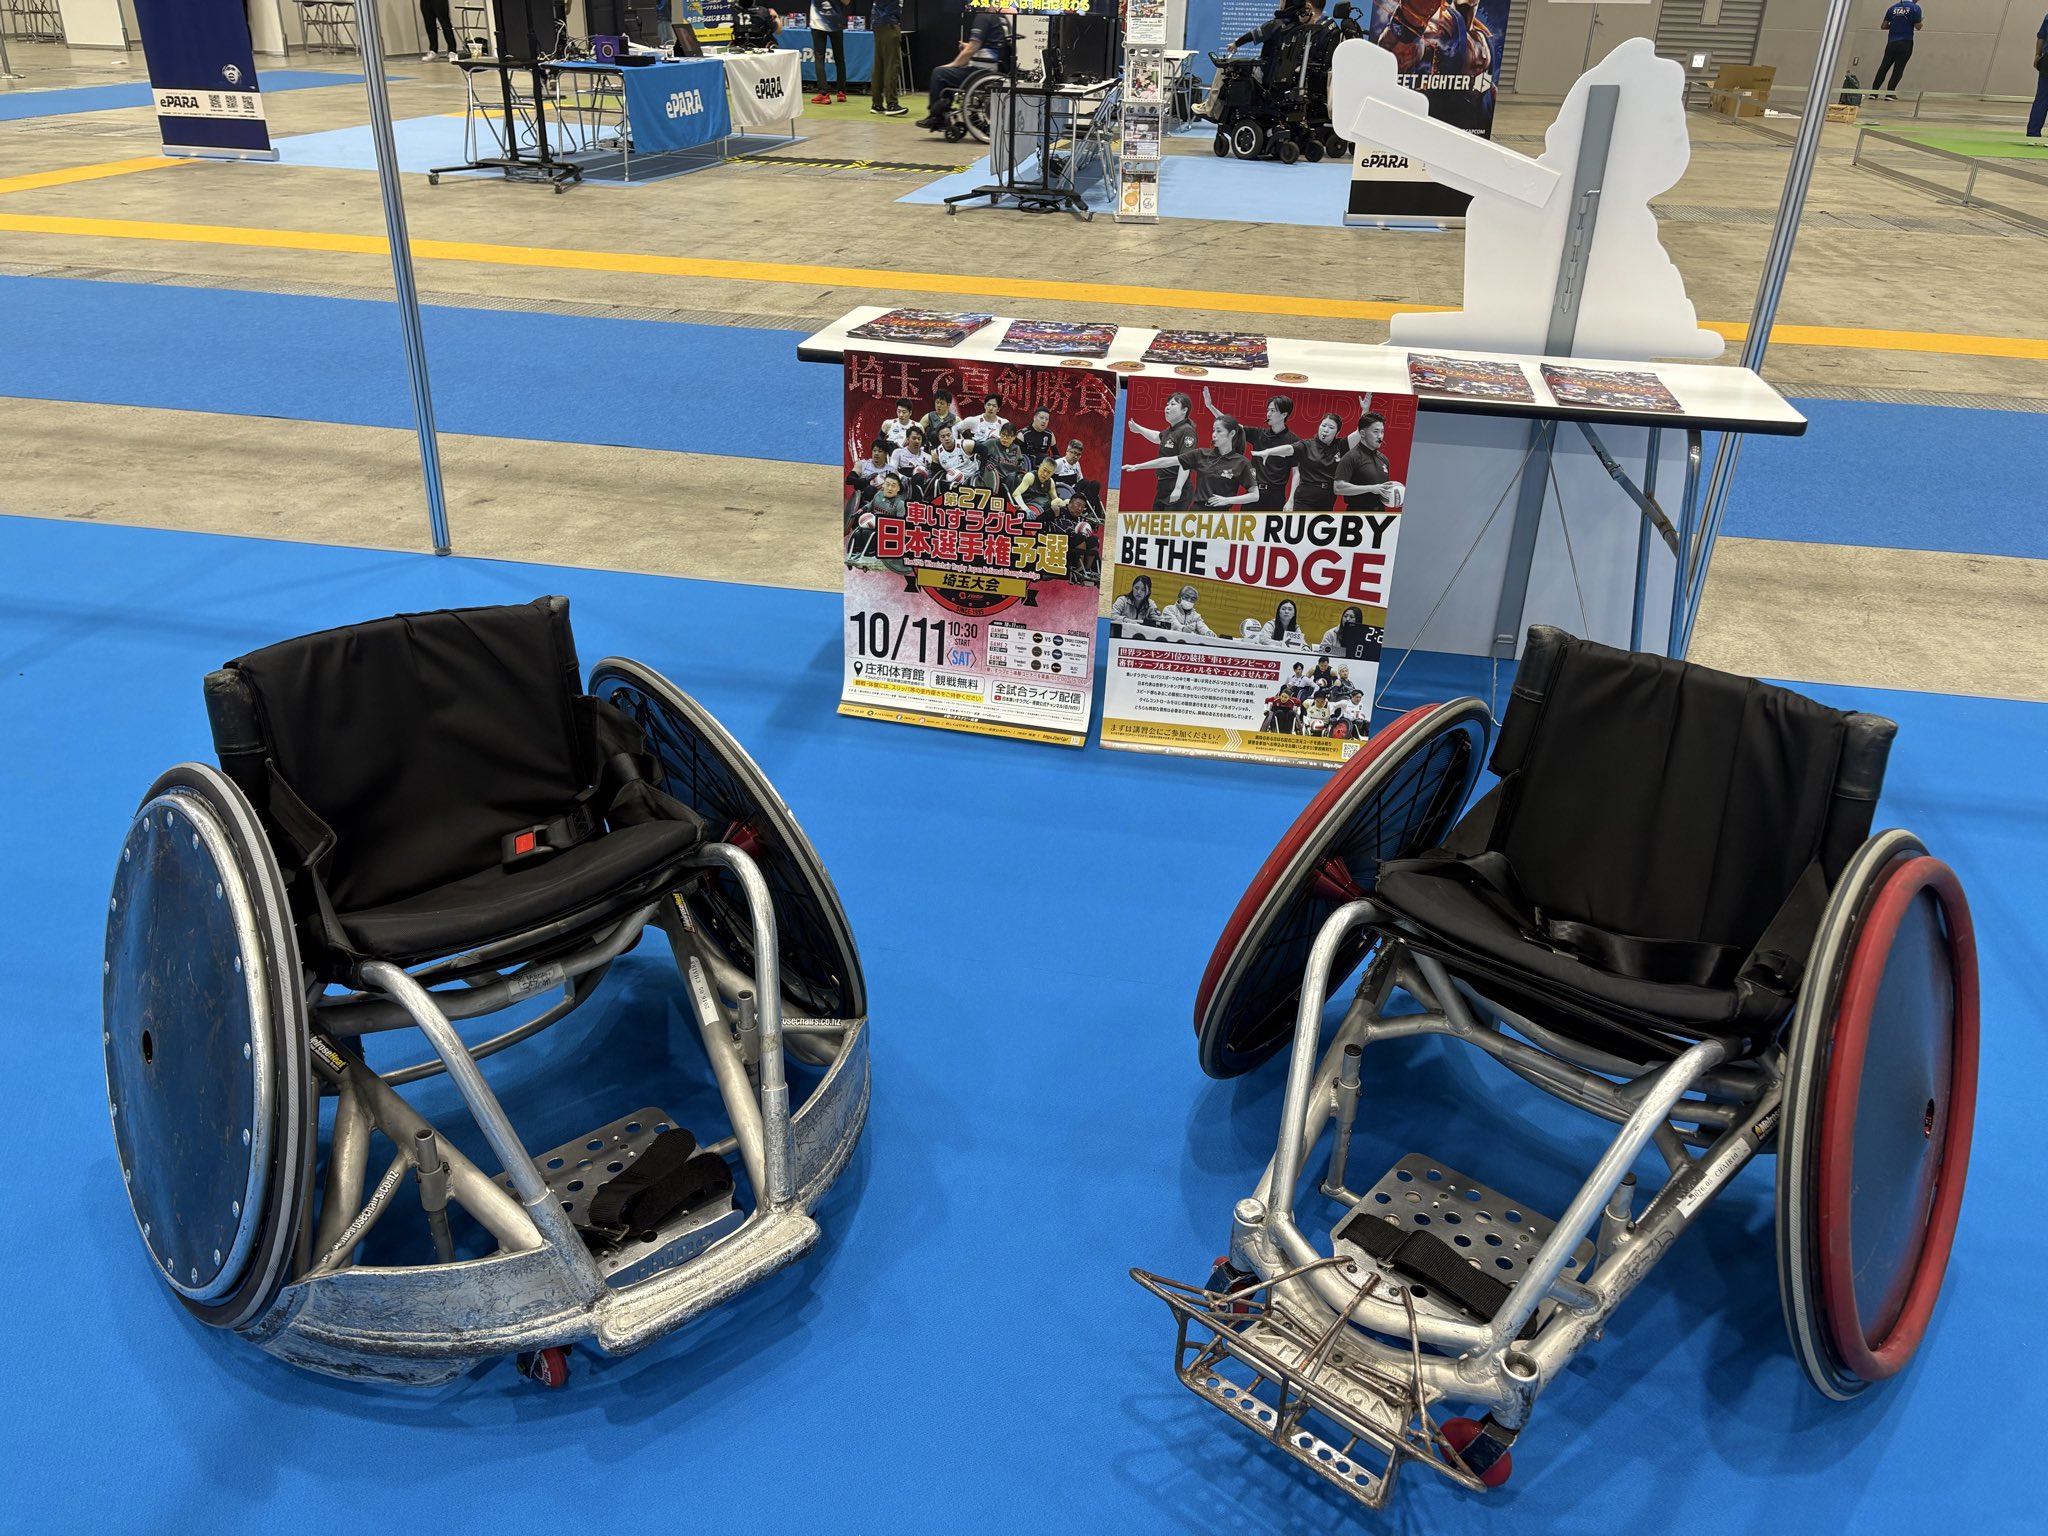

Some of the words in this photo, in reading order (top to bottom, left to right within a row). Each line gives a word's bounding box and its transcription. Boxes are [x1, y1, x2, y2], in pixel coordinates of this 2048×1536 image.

[737, 13, 752, 26] 12
[755, 76, 785, 100] ePARA
[1420, 74, 1471, 91] FIGHTER
[160, 95, 199, 109] ePARA
[665, 89, 704, 119] ePARA
[1361, 154, 1409, 168] ePARA
[849, 354, 1116, 419] 埼玉で真剣勝負
[944, 487, 1005, 512] 第27回
[905, 501, 1043, 537] 車いすラグビー
[1122, 514, 1258, 542] WHEELCHAIR
[1263, 514, 1398, 550] RUGBY
[876, 516, 1069, 576] 日本選手権予選
[1121, 536, 1148, 567] BE
[1154, 537, 1208, 576] THE
[1215, 543, 1387, 604] JUDGE
[942, 573, 1000, 592] 埼玉大会
[850, 611, 946, 666] 10/11
[948, 621, 978, 639] 10:30
[952, 650, 971, 667] SAT
[864, 662, 925, 682] 庄和体育館
[935, 674, 978, 690] 観戦無料
[995, 682, 1081, 705] 全試合ライブ配信
[782, 1017, 841, 1026] osechairs.co.nz
